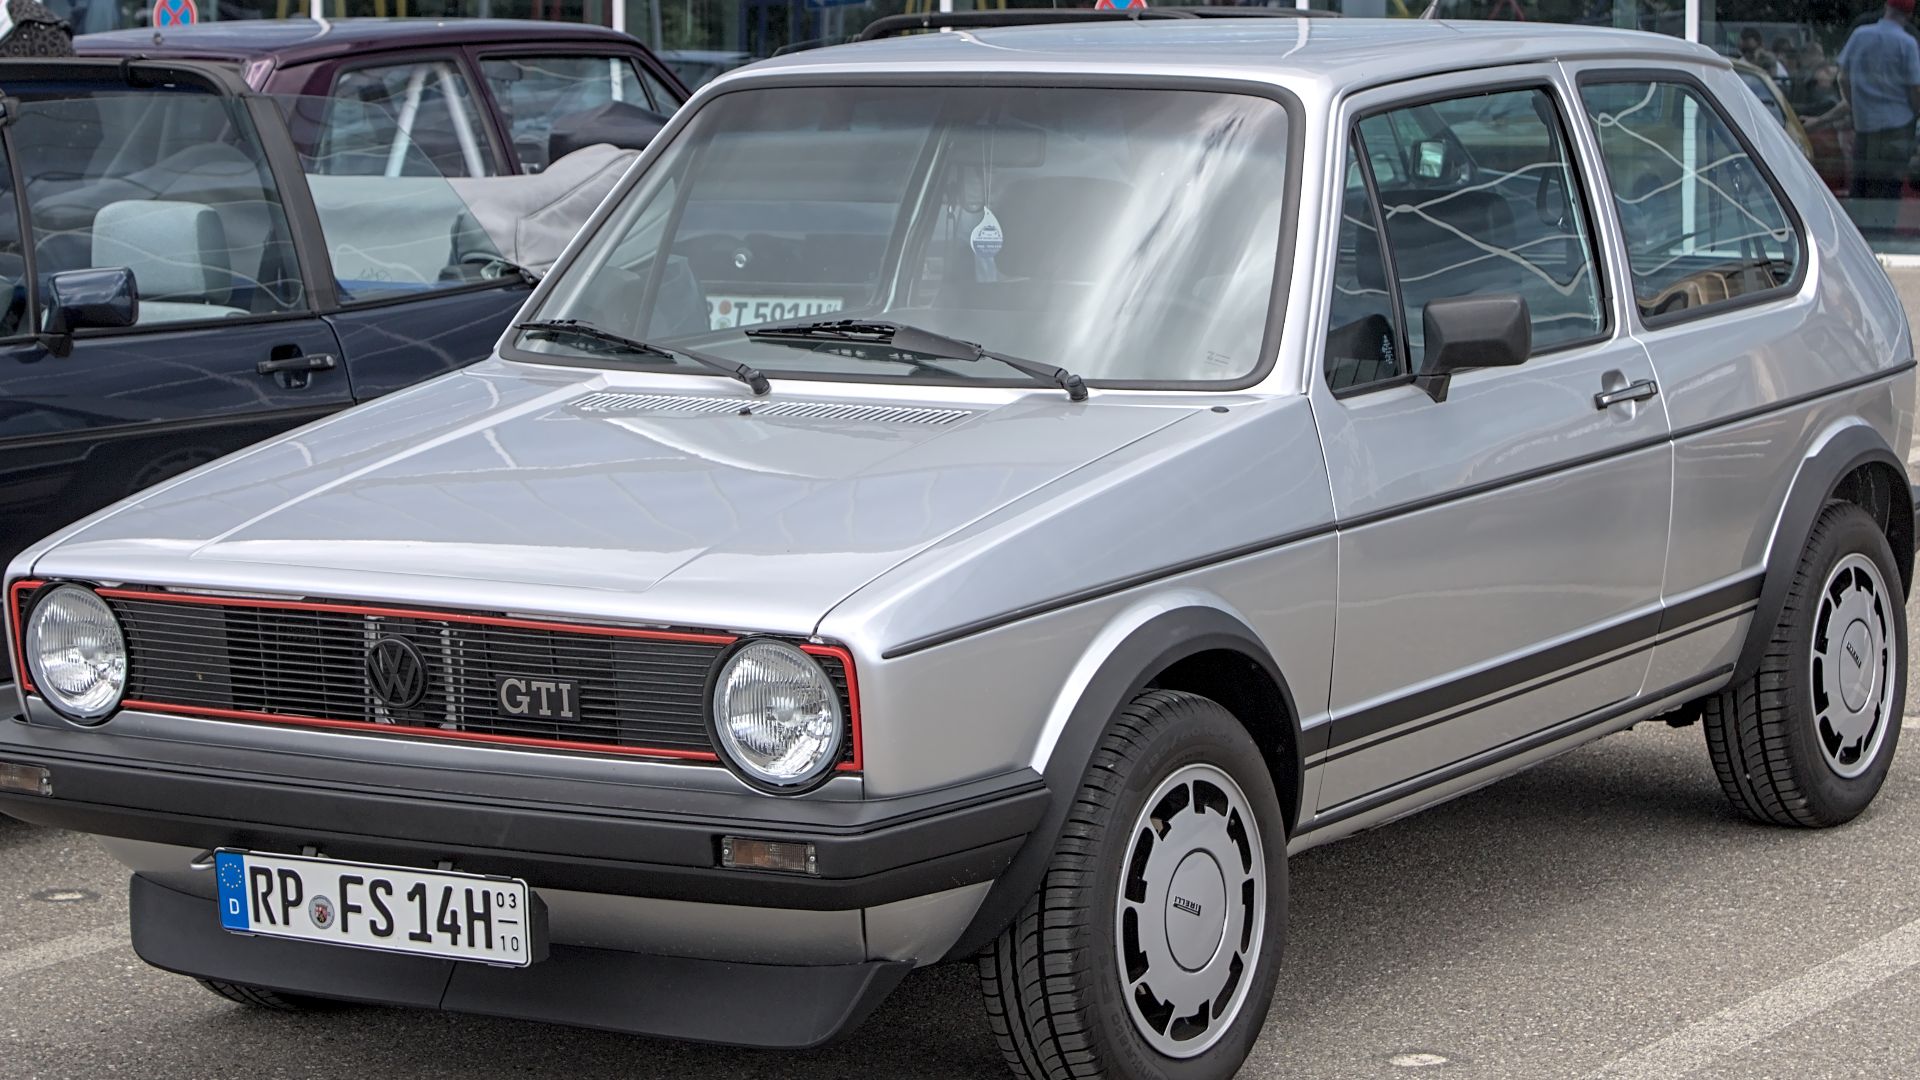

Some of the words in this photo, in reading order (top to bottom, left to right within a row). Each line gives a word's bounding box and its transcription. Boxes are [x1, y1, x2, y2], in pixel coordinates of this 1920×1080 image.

[368, 642, 423, 705] VW
[500, 677, 573, 718] GTI
[229, 897, 241, 915] D
[248, 865, 304, 926] RP
[338, 873, 395, 938] FS
[406, 881, 494, 950] 14H
[496, 891, 517, 909] 03
[1173, 895, 1202, 917] PIRELLI
[500, 934, 519, 952] 10
